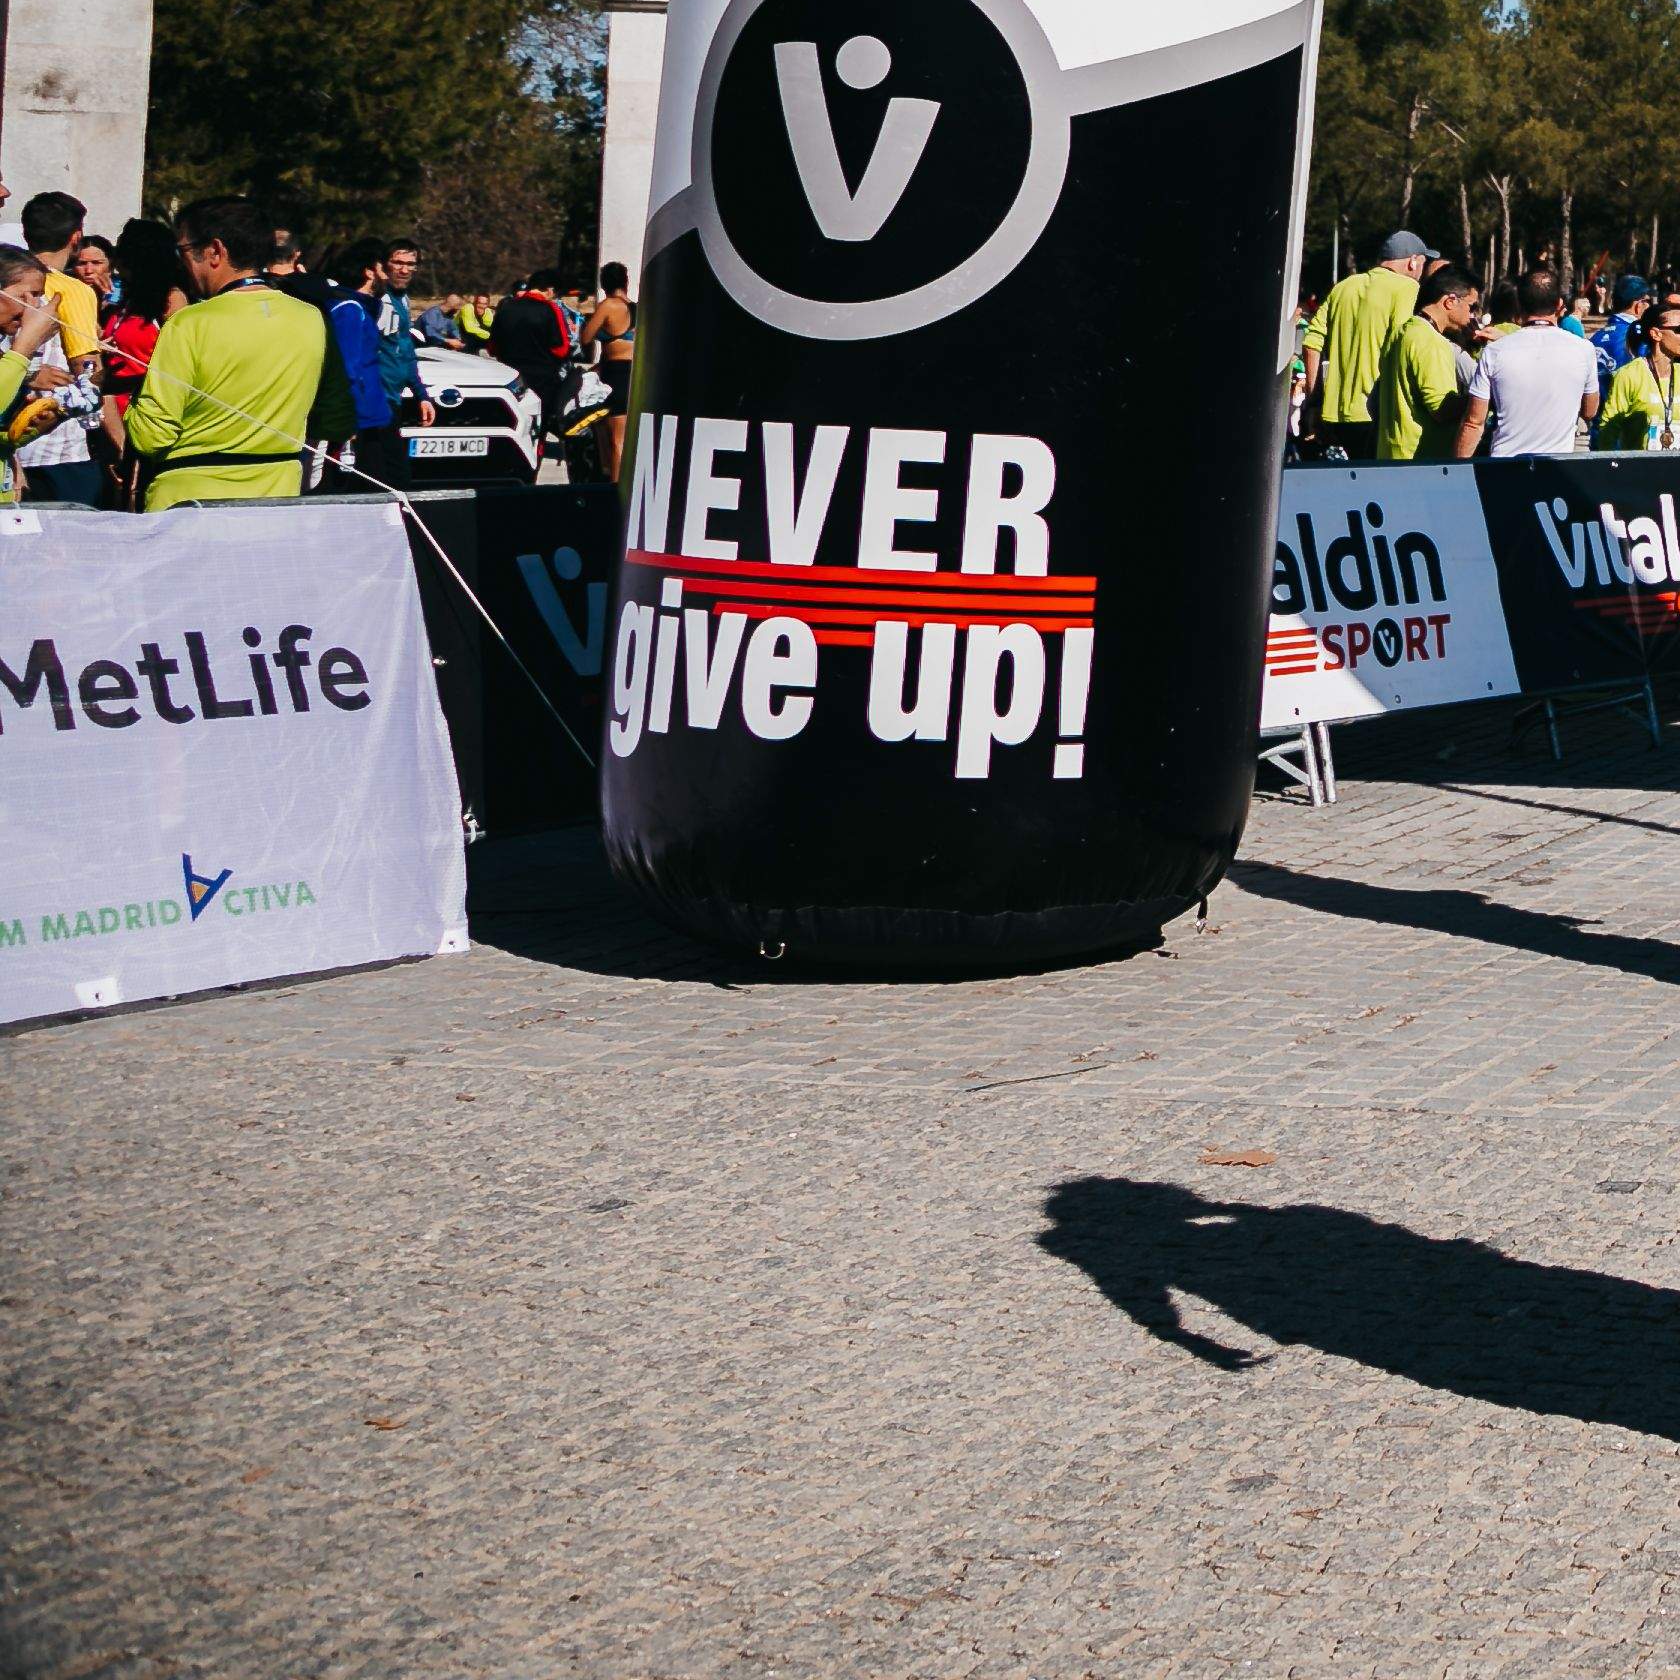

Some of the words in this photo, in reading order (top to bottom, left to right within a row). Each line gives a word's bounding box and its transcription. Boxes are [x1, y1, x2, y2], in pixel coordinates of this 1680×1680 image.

[421, 441, 455, 454] 2218
[627, 414, 1057, 576] NEVER
[0, 624, 372, 732] MetLife
[611, 579, 814, 757] give
[871, 619, 1094, 780] up!
[1321, 614, 1451, 670] SPORT
[42, 899, 182, 942] MADRID
